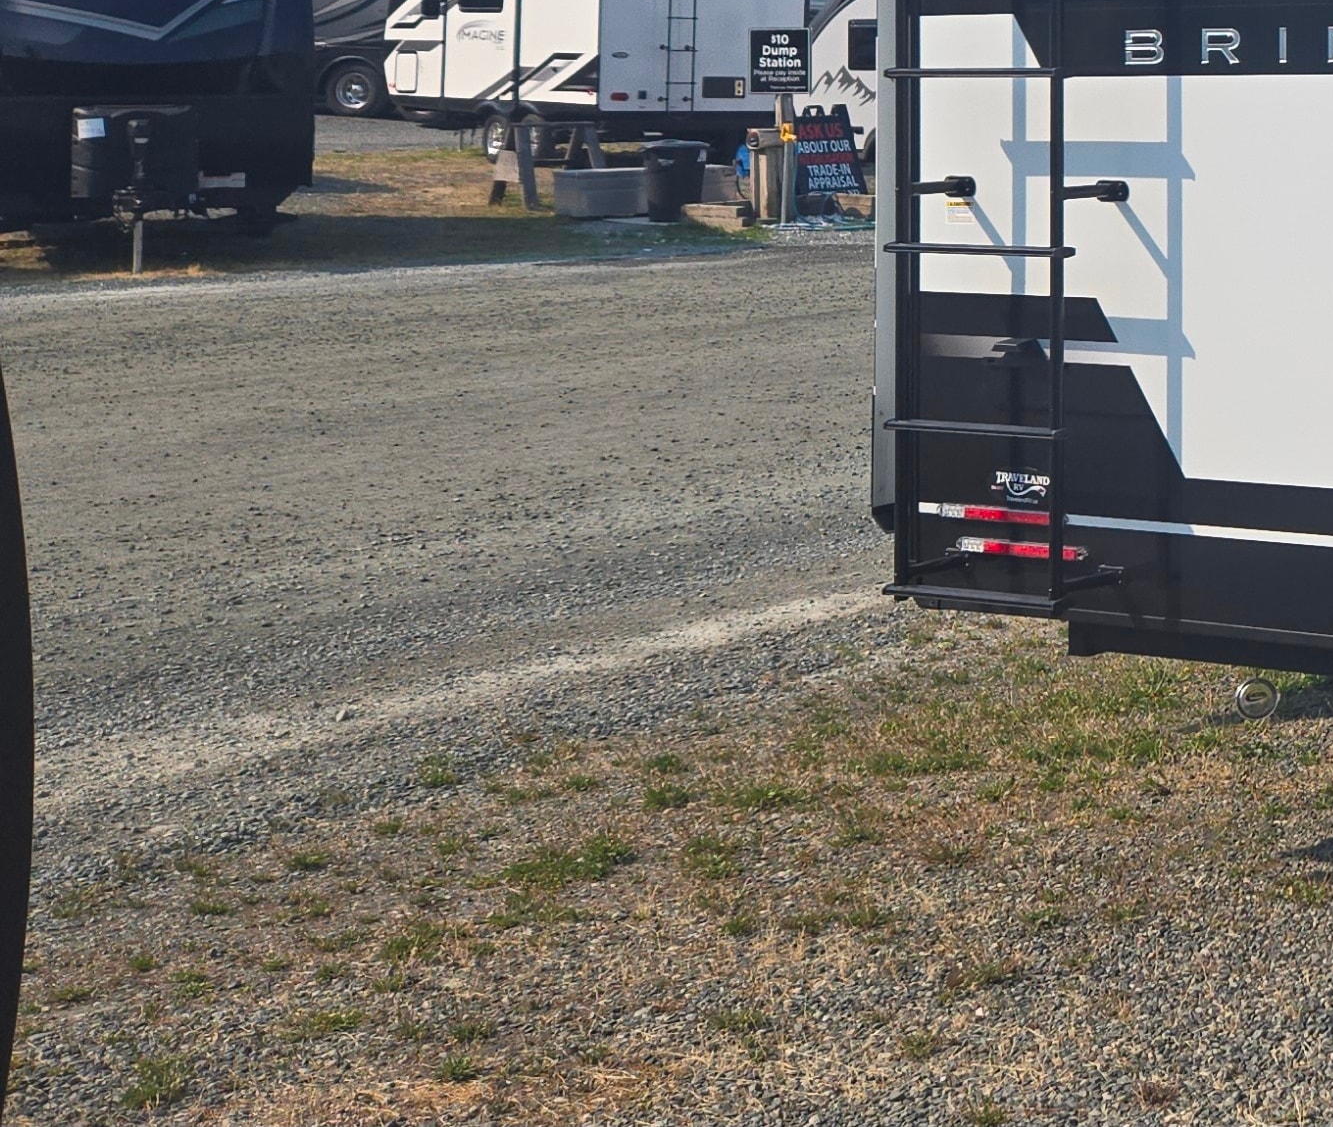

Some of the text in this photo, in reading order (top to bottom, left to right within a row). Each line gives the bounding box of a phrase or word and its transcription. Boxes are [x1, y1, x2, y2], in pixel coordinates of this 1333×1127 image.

[771, 34, 789, 44] $10
[762, 45, 798, 57] Dump
[759, 57, 802, 68] Station
[798, 123, 844, 139] ASK US
[798, 139, 852, 153] ABOUT OUR
[806, 163, 852, 177] TRADE-IN
[808, 175, 860, 190] APPRAISAL
[995, 471, 1050, 486] TRAVELAND
[1013, 483, 1024, 491] RV
